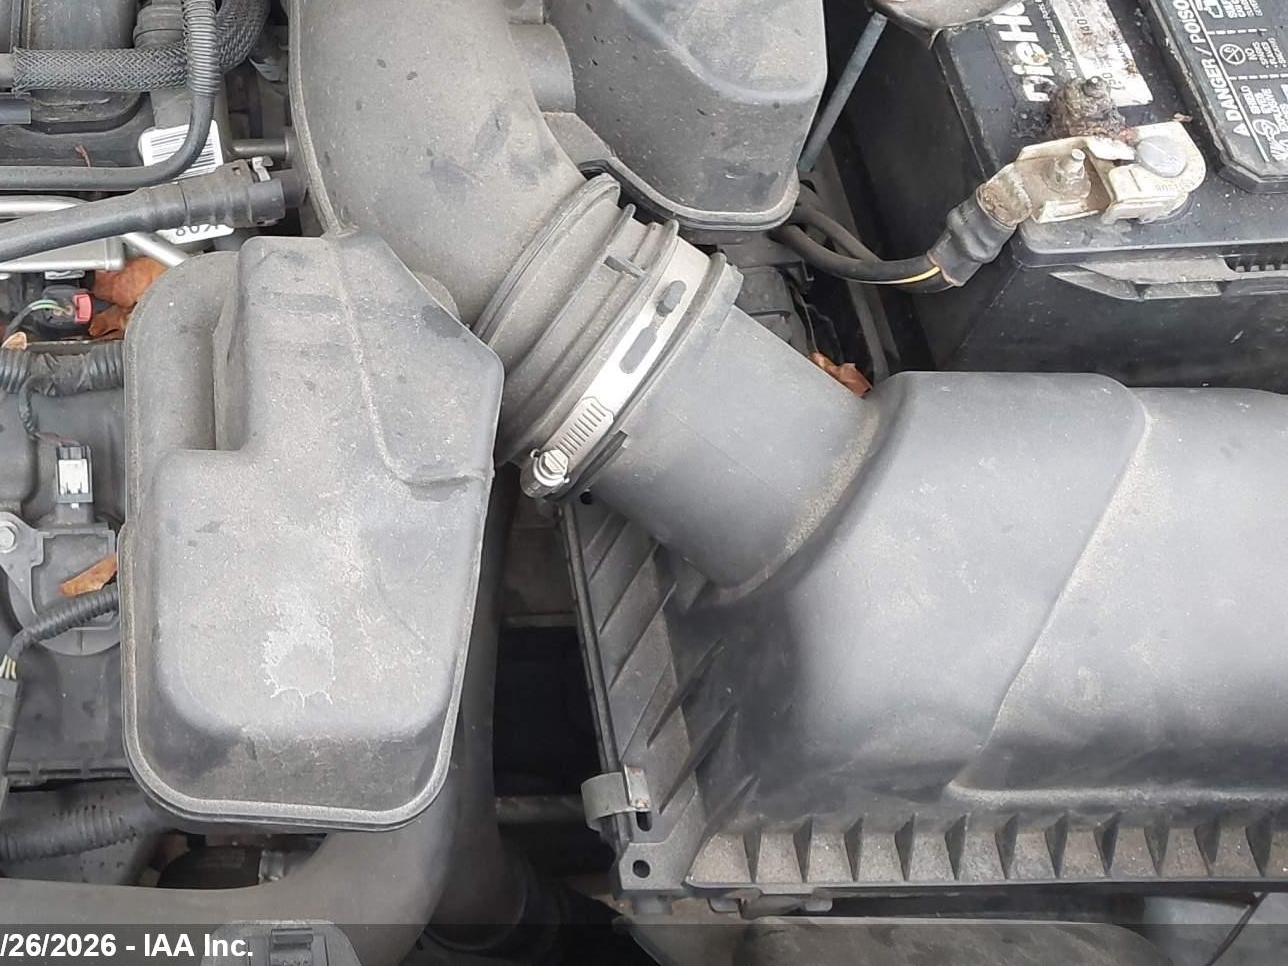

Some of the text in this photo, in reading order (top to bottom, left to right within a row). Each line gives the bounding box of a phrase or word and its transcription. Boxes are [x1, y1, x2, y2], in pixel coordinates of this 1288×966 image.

[1244, 47, 1258, 60] NO
[1201, 59, 1244, 121] DANGER
[1240, 85, 1261, 114] SHIELD
